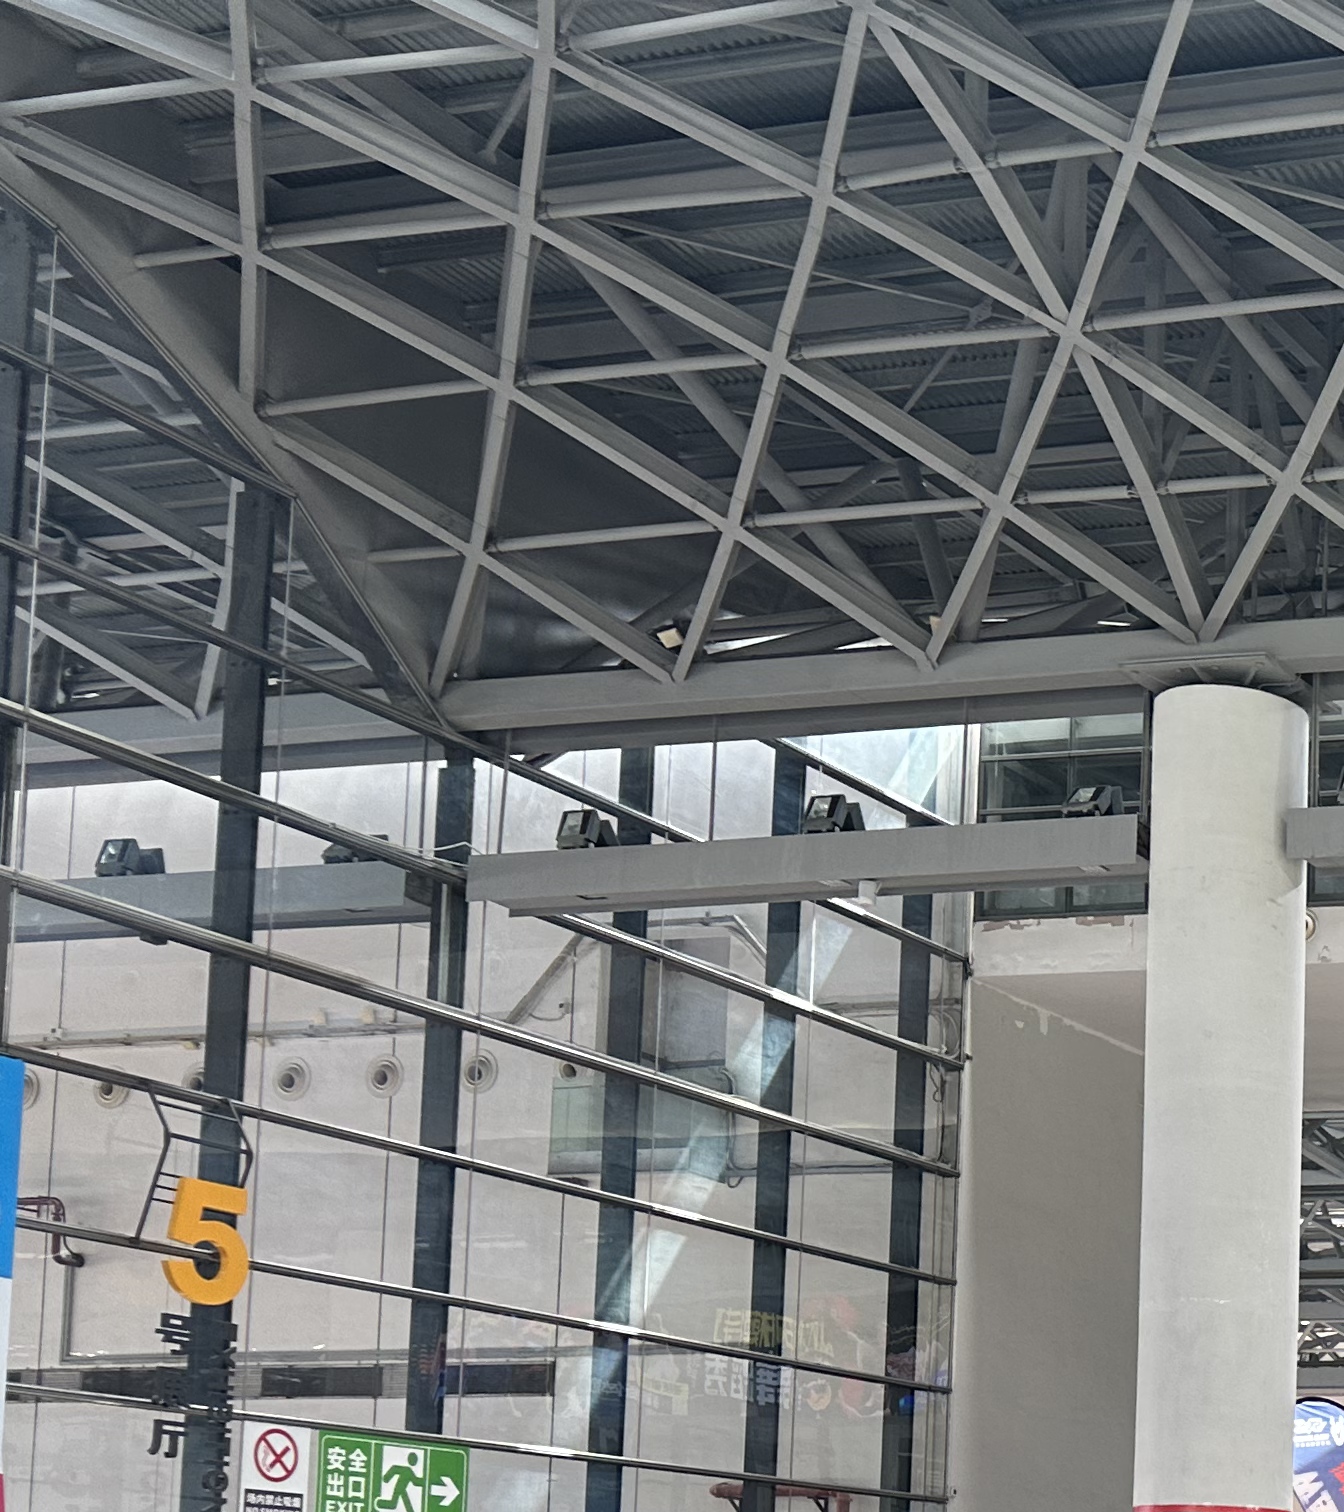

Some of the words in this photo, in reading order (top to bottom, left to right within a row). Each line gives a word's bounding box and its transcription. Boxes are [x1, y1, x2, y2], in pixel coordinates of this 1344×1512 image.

[162, 1177, 249, 1306] 5
[326, 1446, 368, 1473] 安全
[326, 1473, 366, 1499] 出口
